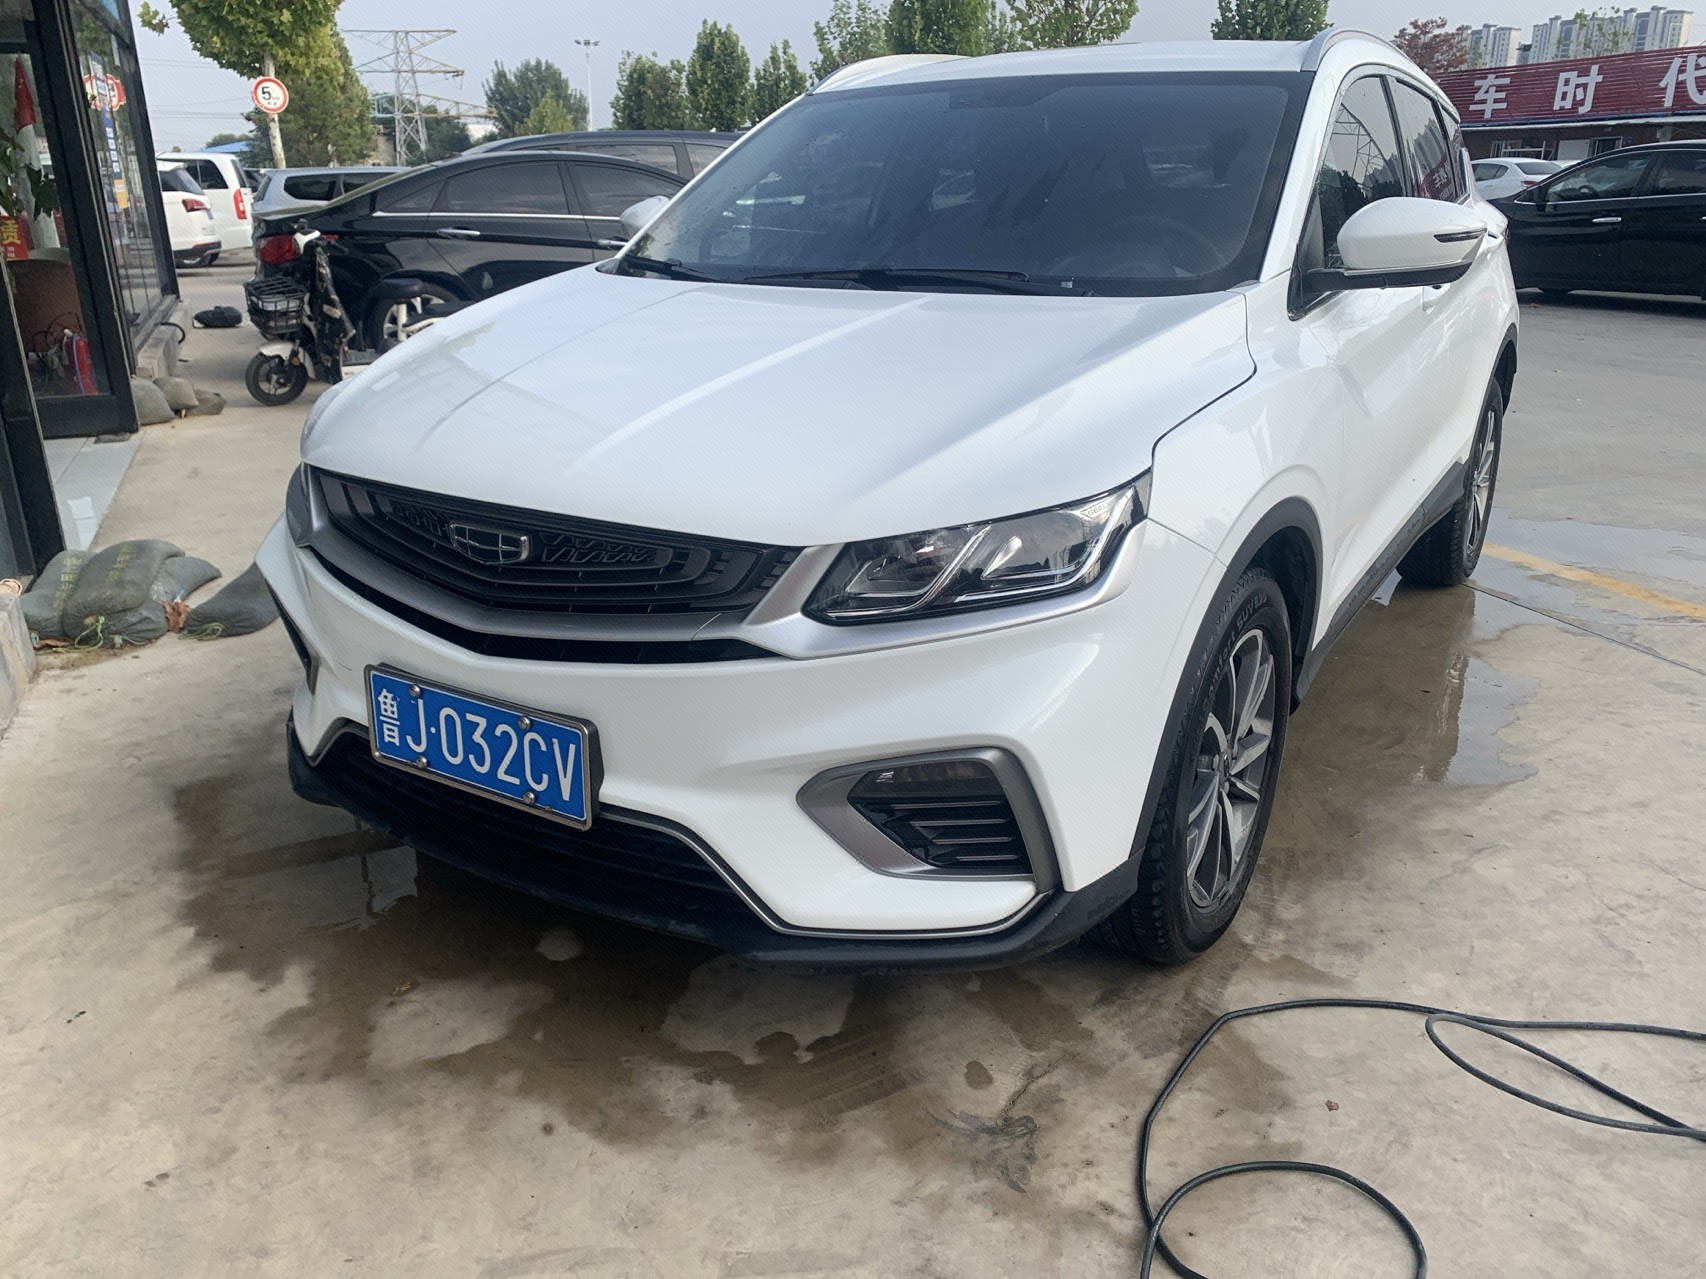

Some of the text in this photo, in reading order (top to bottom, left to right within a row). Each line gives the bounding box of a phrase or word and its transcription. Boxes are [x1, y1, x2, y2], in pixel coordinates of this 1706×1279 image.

[261, 86, 271, 101] 5
[1468, 54, 1706, 119] 车时代
